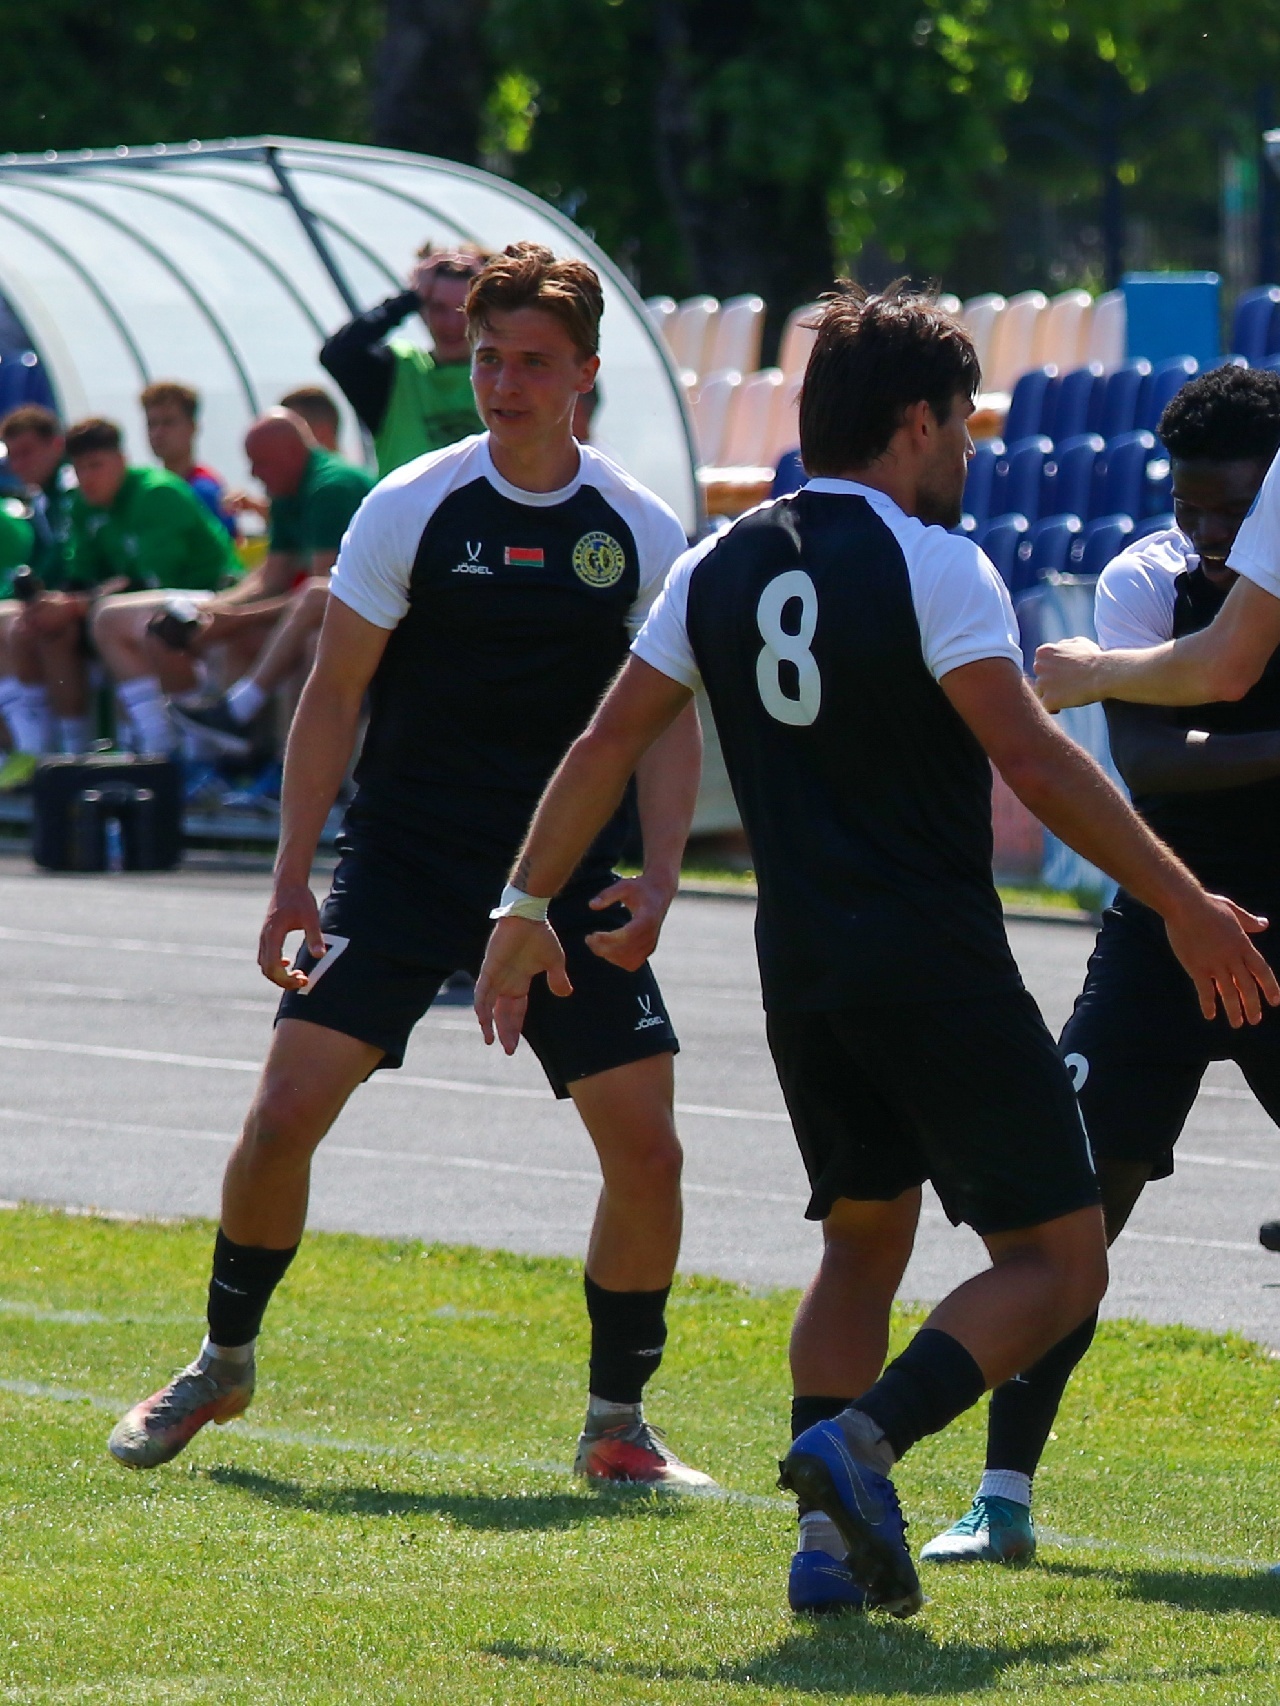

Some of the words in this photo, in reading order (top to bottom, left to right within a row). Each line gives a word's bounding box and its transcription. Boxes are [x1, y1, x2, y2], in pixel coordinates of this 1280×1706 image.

[451, 562, 494, 575] JÖGEL
[756, 569, 822, 726] 8
[297, 933, 350, 996] 7
